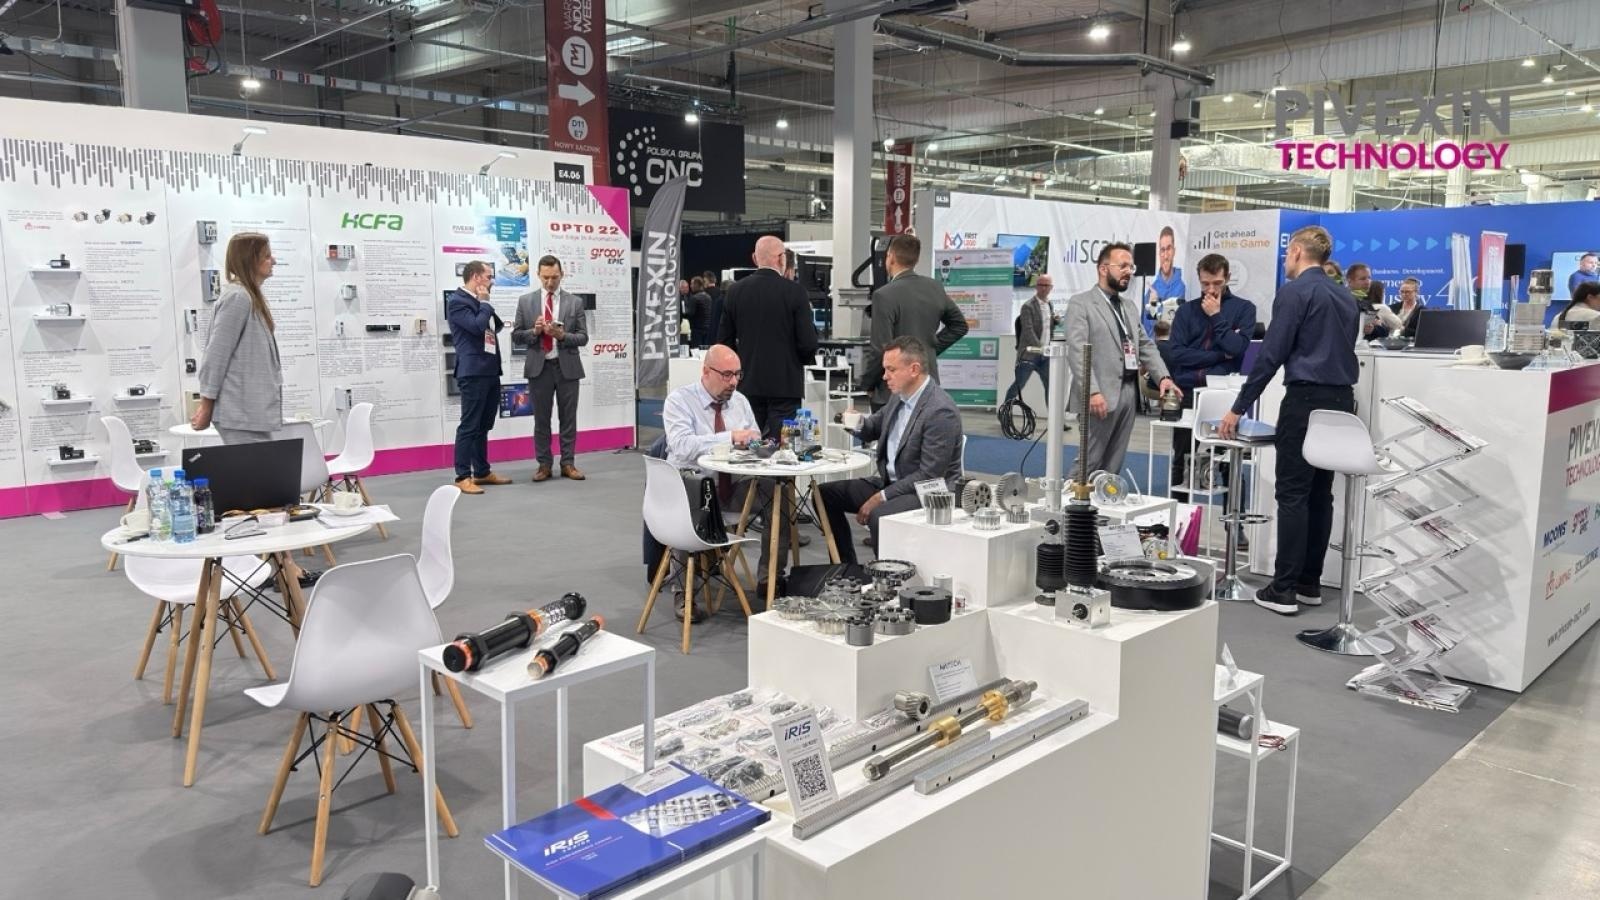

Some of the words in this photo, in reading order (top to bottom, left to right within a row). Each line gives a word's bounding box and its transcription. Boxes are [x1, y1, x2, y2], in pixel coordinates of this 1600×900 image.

[646, 146, 676, 157] POLSKA
[678, 150, 702, 161] GRUPA
[558, 169, 581, 180] E4.06
[646, 158, 703, 187] CNC
[550, 223, 594, 234] OPTO
[598, 225, 619, 235] 22
[1213, 230, 1229, 239] Get
[1230, 229, 1256, 238] ahead
[1221, 239, 1238, 249] the
[1240, 239, 1271, 249] Game
[590, 248, 625, 260] groov
[641, 231, 667, 360] PIVEXIN
[664, 233, 679, 358] TECHNOLOGY
[592, 343, 627, 356] groov
